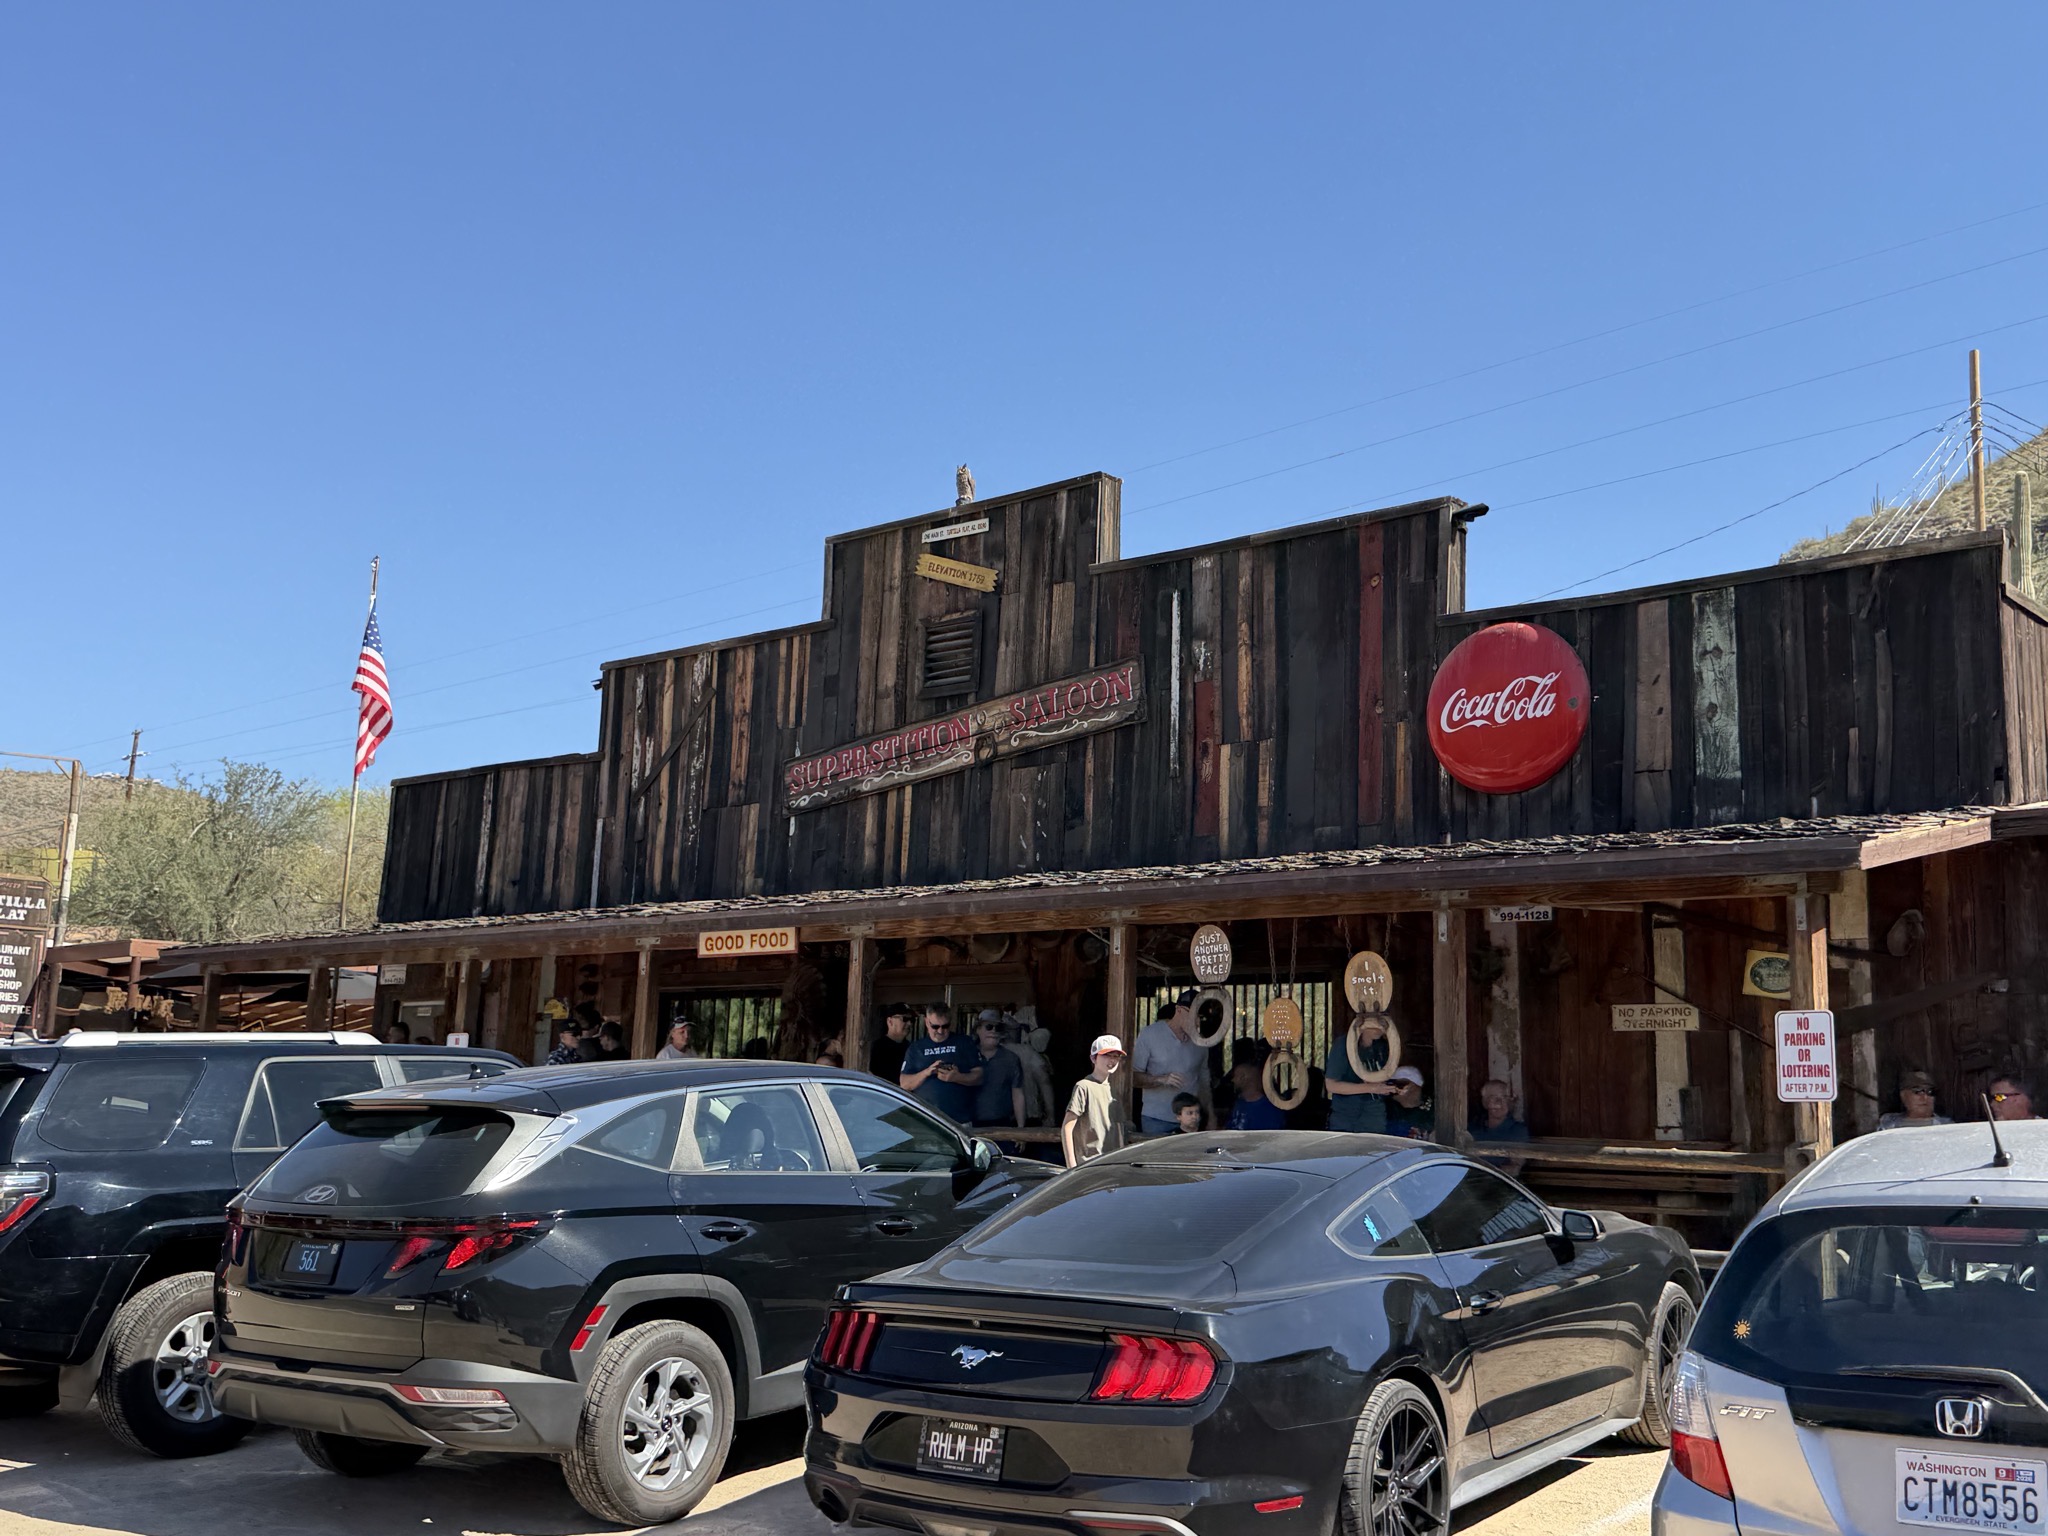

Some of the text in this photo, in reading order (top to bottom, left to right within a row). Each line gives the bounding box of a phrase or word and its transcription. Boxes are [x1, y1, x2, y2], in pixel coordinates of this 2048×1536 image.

[928, 562, 967, 580] ELEVATION
[1440, 670, 1562, 733] Coca-Cola
[789, 667, 1134, 795] SUPERSTITION SALOON
[1500, 910, 1549, 922] 994-1128
[705, 932, 789, 952] GOOD FOOD
[1199, 933, 1221, 945] JUST
[1194, 944, 1229, 954] ANOTHER
[1195, 954, 1230, 966] PRETTY
[1364, 960, 1369, 970] I
[1200, 963, 1229, 975] FACE!
[1352, 972, 1385, 984] smelt
[1363, 986, 1378, 996] it.
[0, 1004, 31, 1015] OFFICE
[1618, 1007, 1692, 1018] NO PARKING
[1623, 1019, 1688, 1028] OVERNIGHT
[1796, 1016, 1810, 1030] NO
[1784, 1032, 1826, 1046] PARKING
[1797, 1048, 1811, 1062] OR
[1782, 1064, 1830, 1078] LOITERING
[1785, 1083, 1830, 1093] AFTER 7 P.M.
[299, 1250, 320, 1271] 561
[1720, 1404, 1775, 1420] FIT
[949, 1422, 978, 1432] ARIZONA
[929, 1431, 967, 1462] RHLM
[973, 1437, 993, 1465] HP
[1906, 1461, 1987, 1478] WASHINGTON
[1998, 1468, 2006, 1478] 9
[1904, 1476, 2038, 1524] CTM8556
[1936, 1515, 2008, 1529] EVERGREEN STATE
